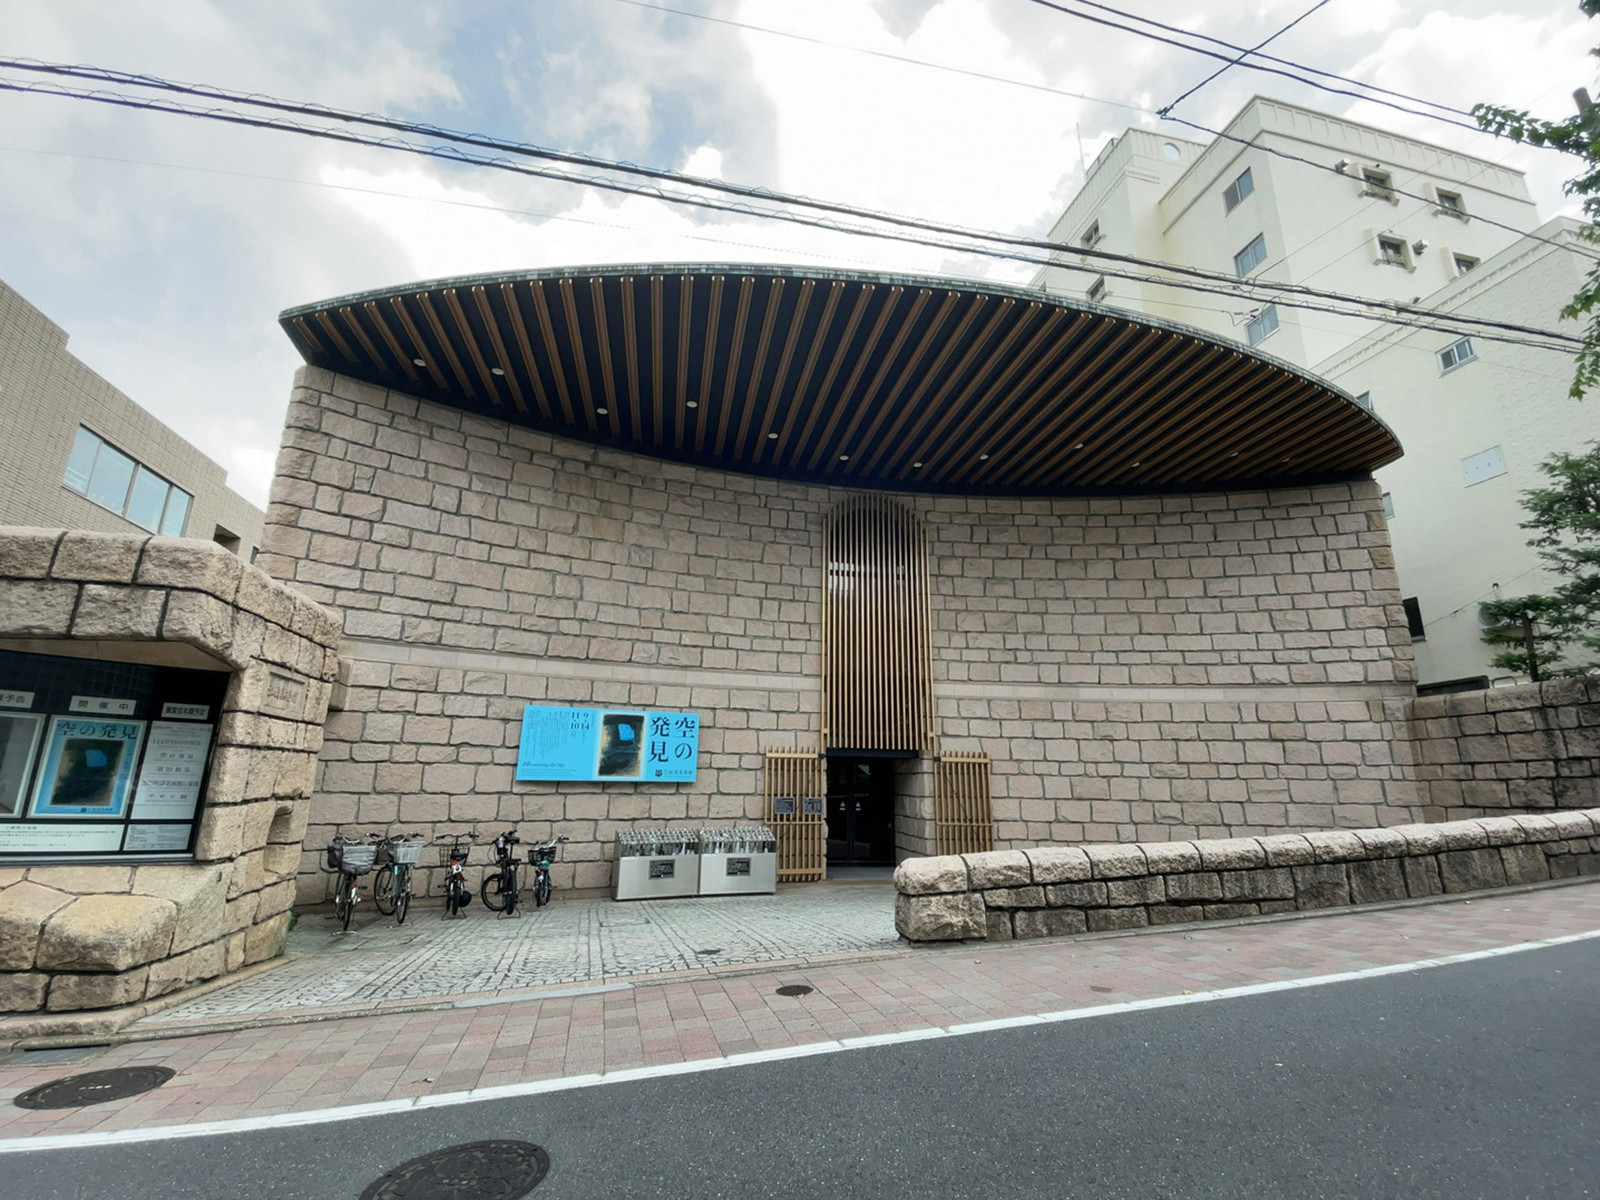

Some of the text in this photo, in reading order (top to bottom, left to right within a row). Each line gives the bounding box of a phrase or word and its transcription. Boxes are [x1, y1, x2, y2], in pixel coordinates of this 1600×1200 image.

[78, 700, 129, 710] 開催中
[58, 721, 137, 740] 空の発見
[648, 716, 671, 763] 発見
[674, 717, 696, 760] 空の
